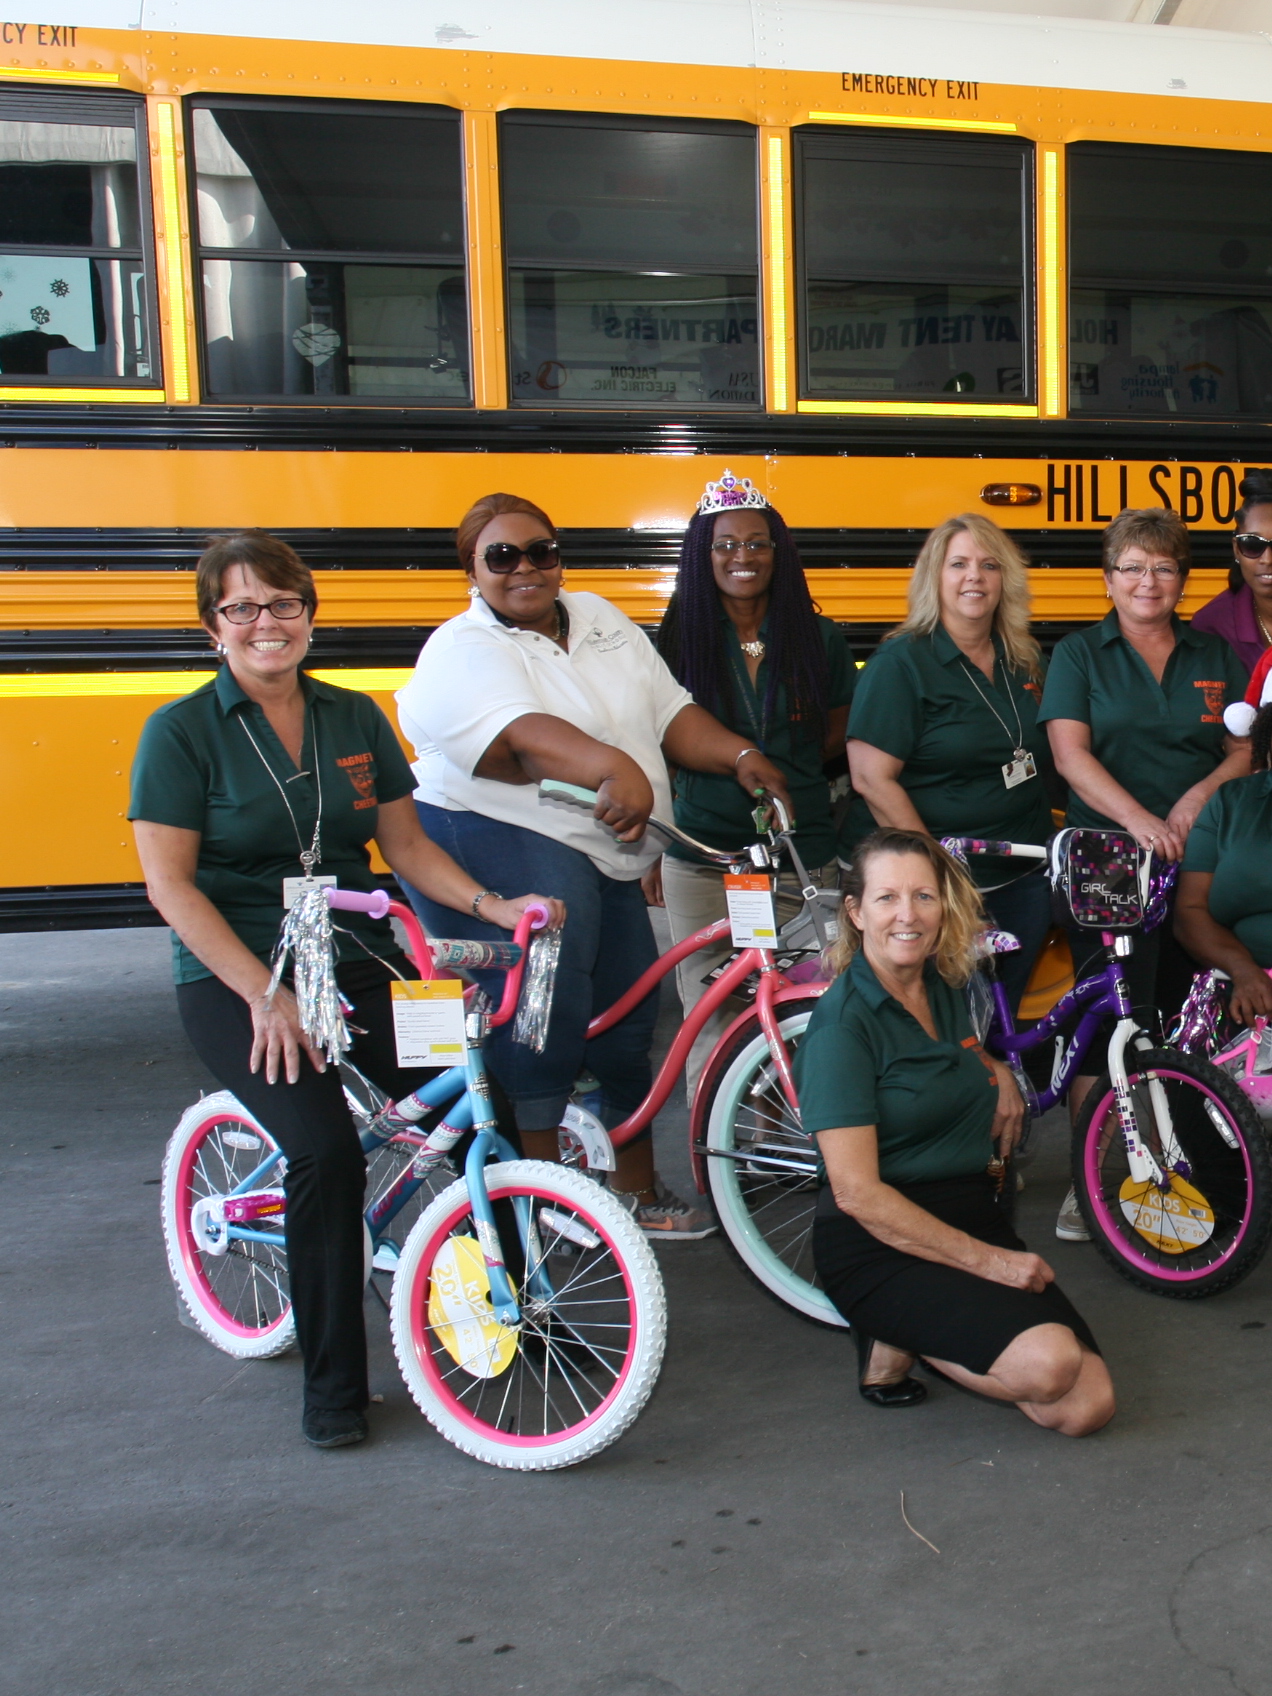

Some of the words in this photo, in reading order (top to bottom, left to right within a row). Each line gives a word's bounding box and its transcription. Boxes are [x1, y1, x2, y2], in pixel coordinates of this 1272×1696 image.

[38, 24, 78, 47] EXIT
[842, 72, 938, 97] EMERGENCY
[947, 80, 980, 100] EXIT
[1193, 680, 1227, 689] MAGNET
[1081, 882, 1111, 895] GIRL
[1103, 893, 1138, 905] TALK
[1050, 1036, 1079, 1096] NEXT
[1149, 1193, 1181, 1212] KIDS
[434, 1264, 462, 1306] 20"
[465, 1280, 497, 1327] KIDS
